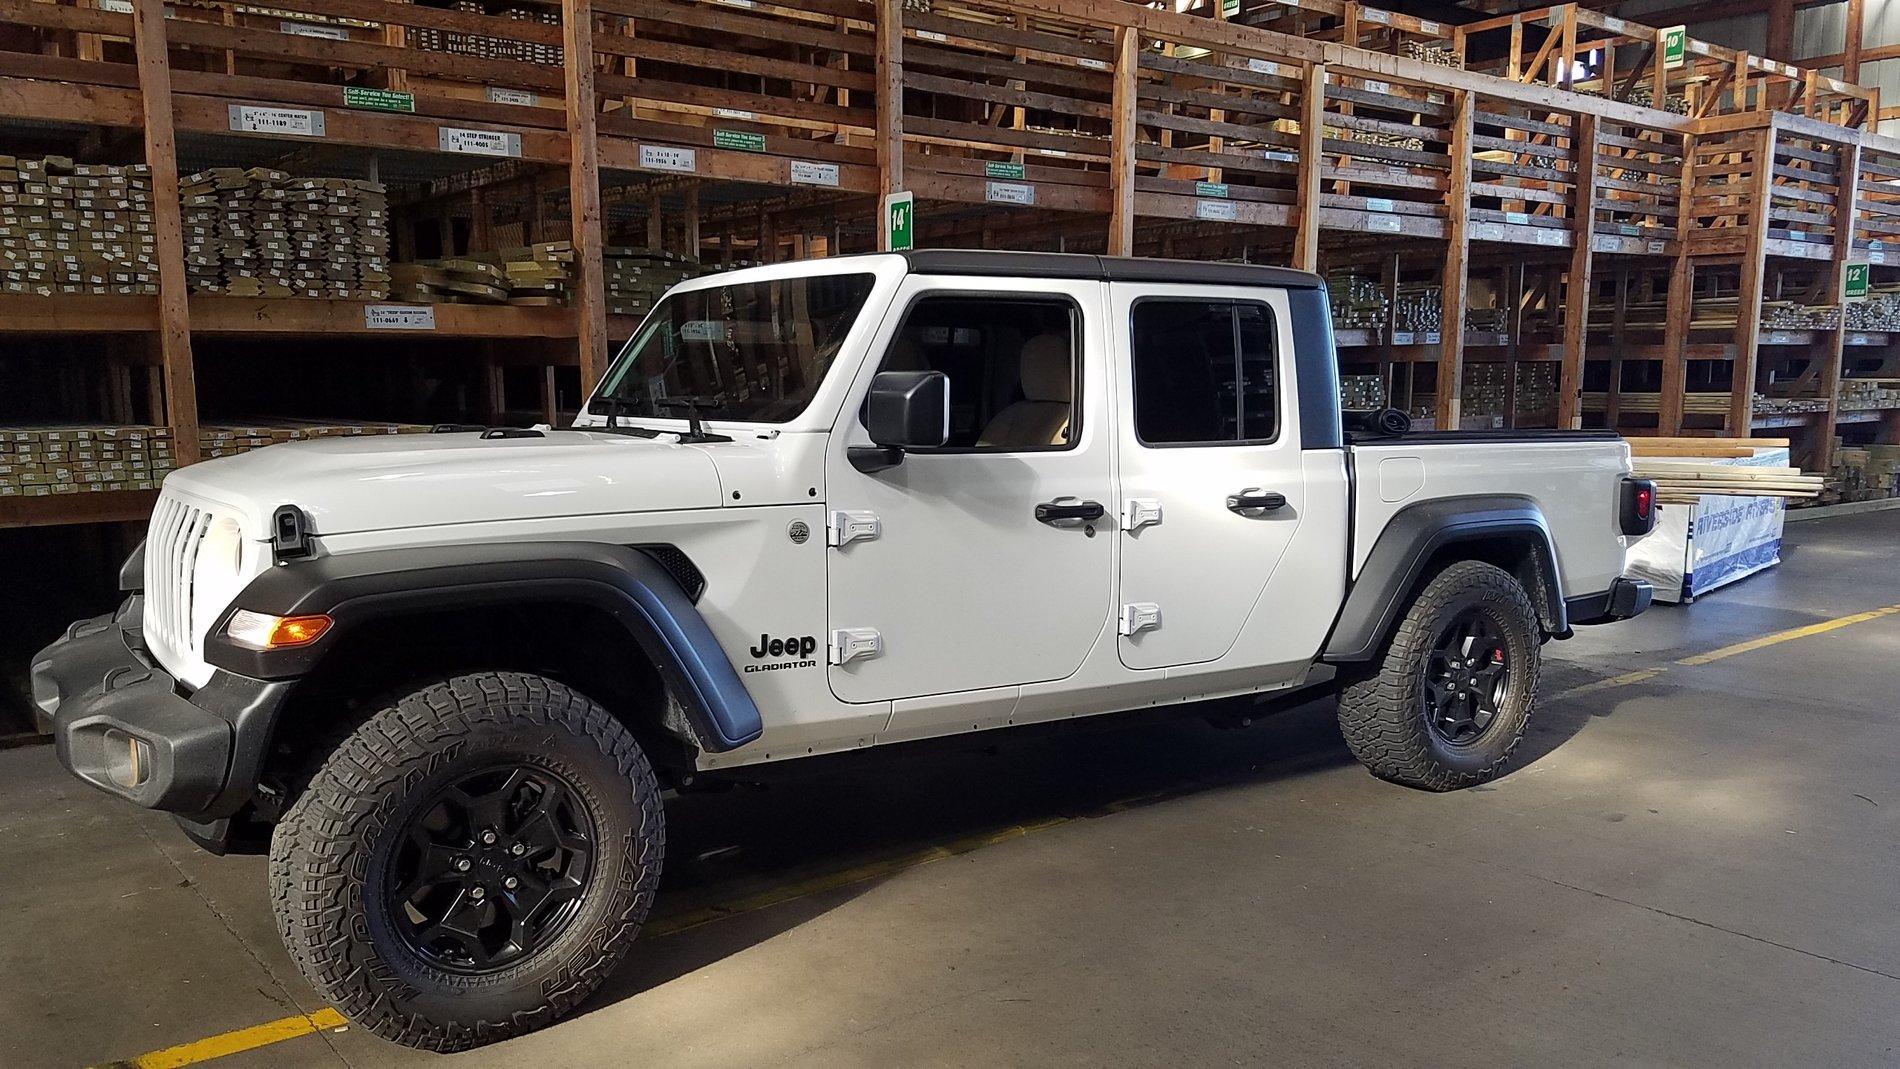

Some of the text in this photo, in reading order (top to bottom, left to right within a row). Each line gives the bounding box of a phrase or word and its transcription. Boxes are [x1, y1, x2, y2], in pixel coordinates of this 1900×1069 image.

[1667, 32, 1683, 48] 10'
[892, 204, 909, 231] 14'
[1847, 265, 1867, 282] 12'
[750, 633, 816, 659] Jeep
[744, 660, 817, 673] GLADIATOR
[540, 827, 641, 1001] FALKEN
